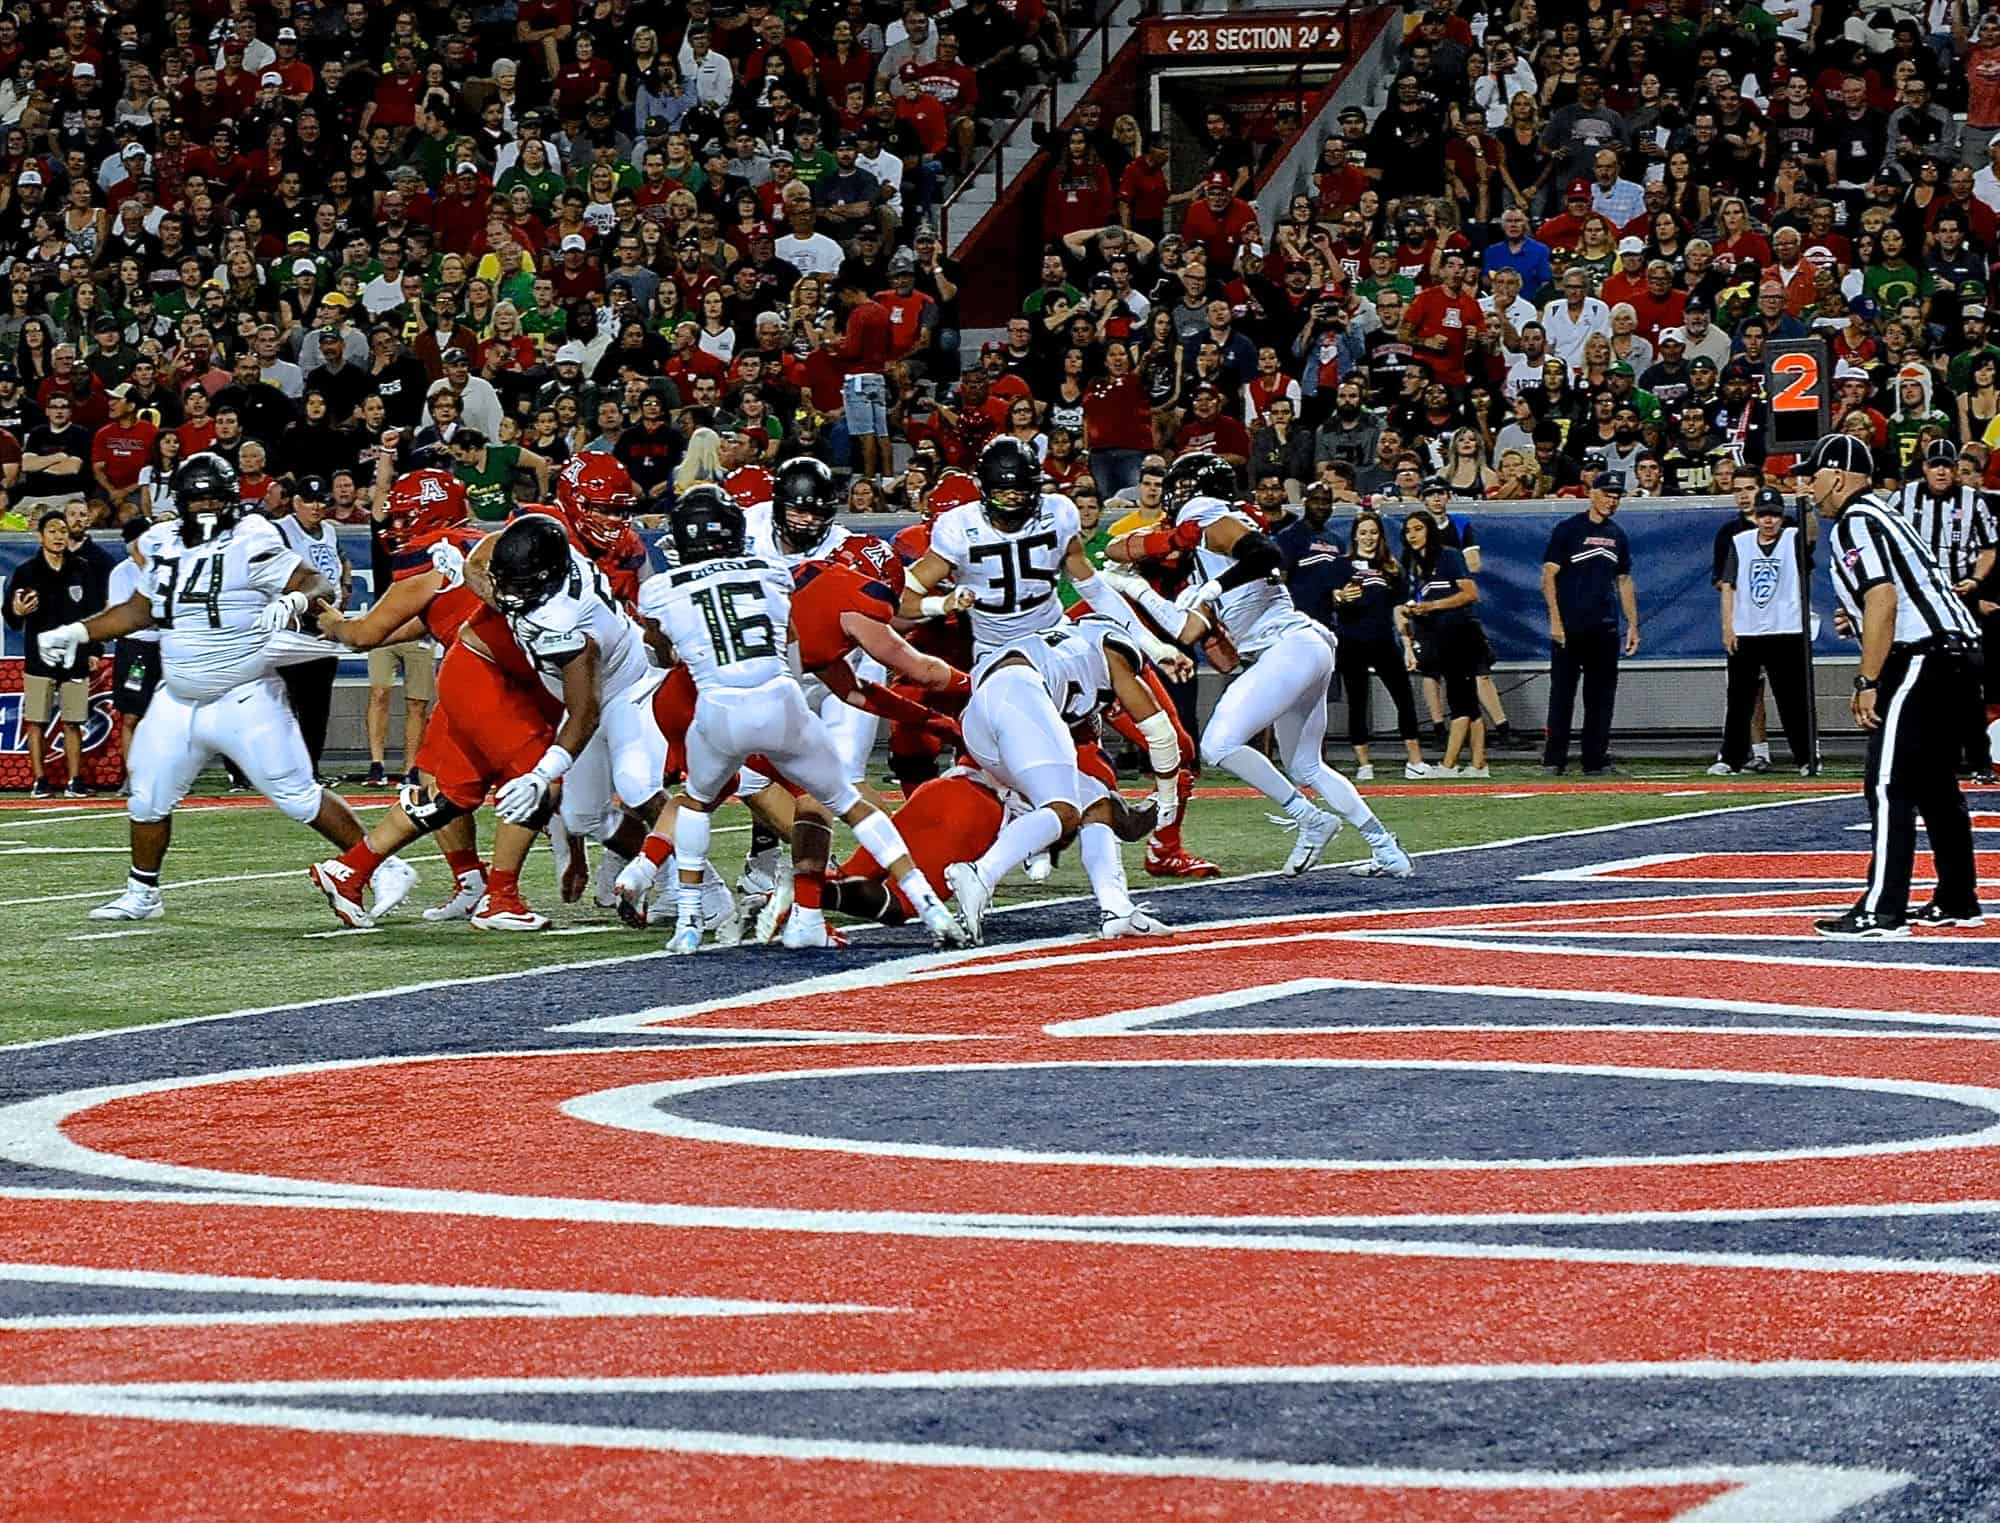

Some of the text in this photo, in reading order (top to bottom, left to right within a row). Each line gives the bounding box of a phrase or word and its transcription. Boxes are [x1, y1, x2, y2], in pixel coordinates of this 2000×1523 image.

[1187, 26, 1320, 50] 23 SECTION 24
[1771, 353, 1820, 412] 2
[419, 477, 449, 505] A
[861, 541, 894, 576] A
[968, 530, 1057, 613] 35
[151, 554, 223, 629] 34
[1755, 585, 1770, 598] 12
[690, 580, 777, 666] 16
